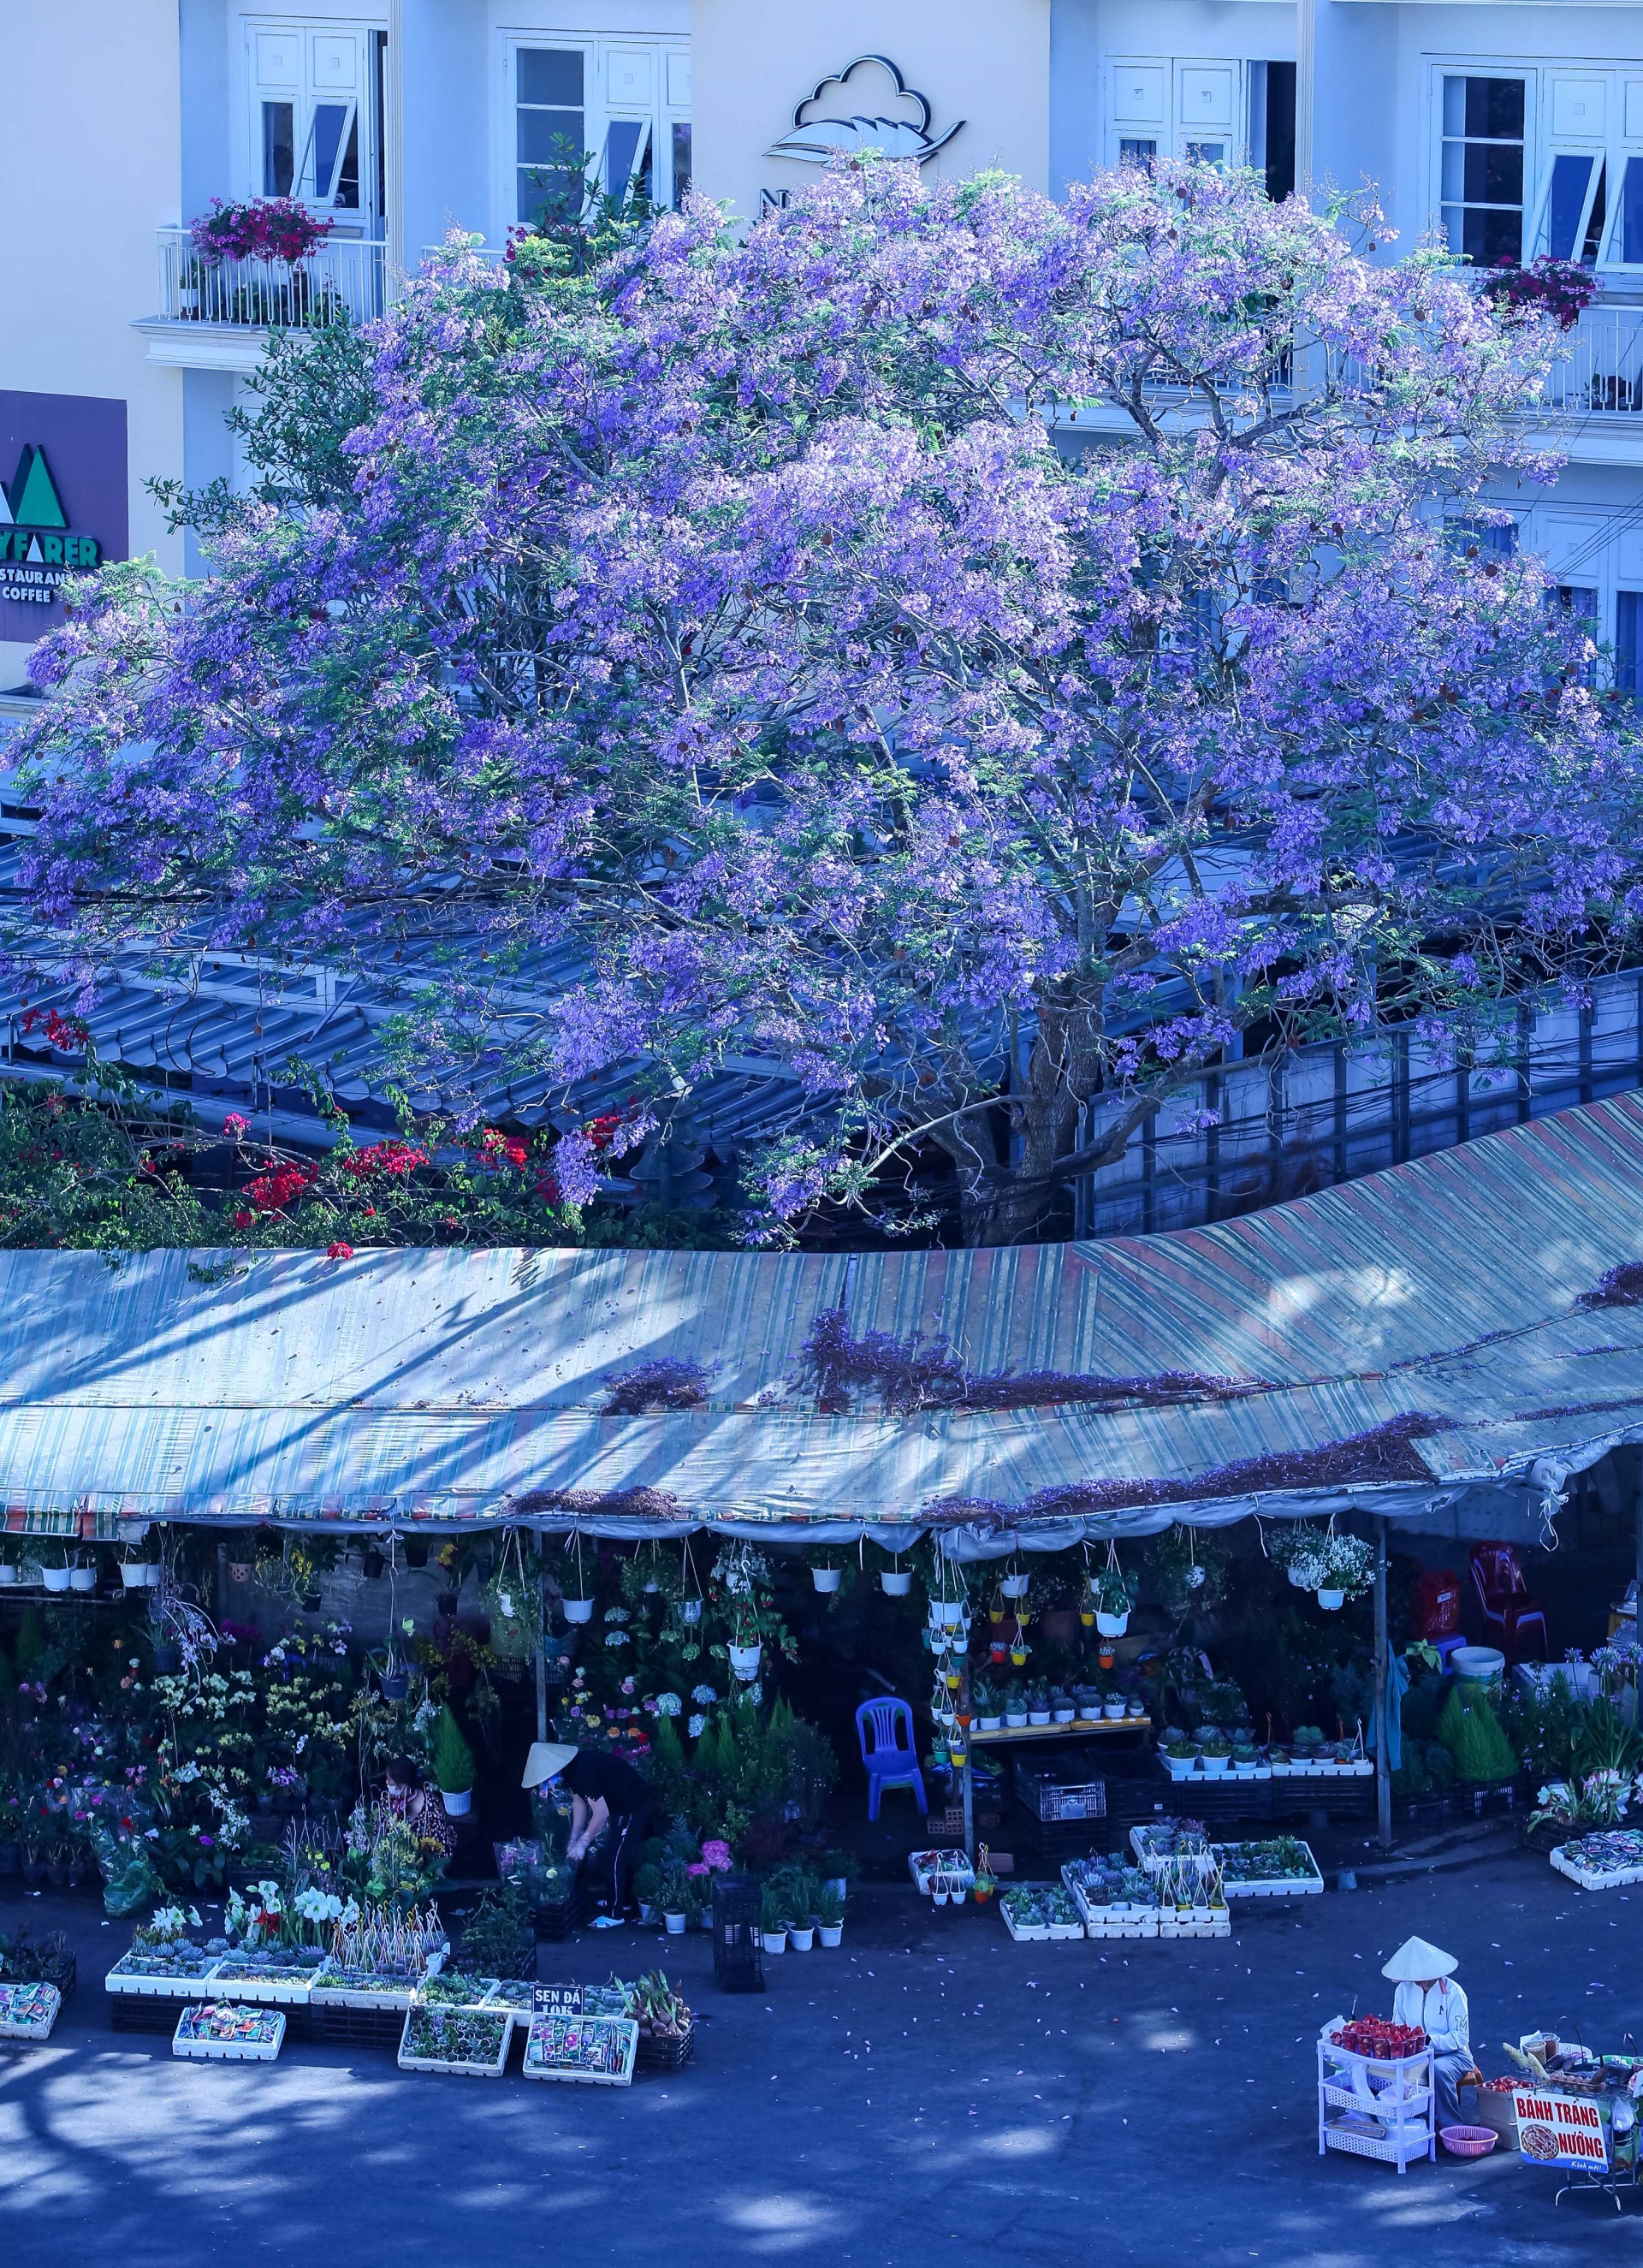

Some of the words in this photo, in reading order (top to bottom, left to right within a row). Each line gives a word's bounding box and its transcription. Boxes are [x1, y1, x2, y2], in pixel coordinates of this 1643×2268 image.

[2, 586, 50, 603] COFFEE
[535, 1989, 559, 2003] SEN
[563, 1989, 581, 2004] ĐÁ
[541, 2004, 574, 2015] 10K
[1516, 2094, 1553, 2122] BÁNH
[1555, 2100, 1599, 2128] TRÁNG
[1558, 2130, 1604, 2158] NƯỚNG
